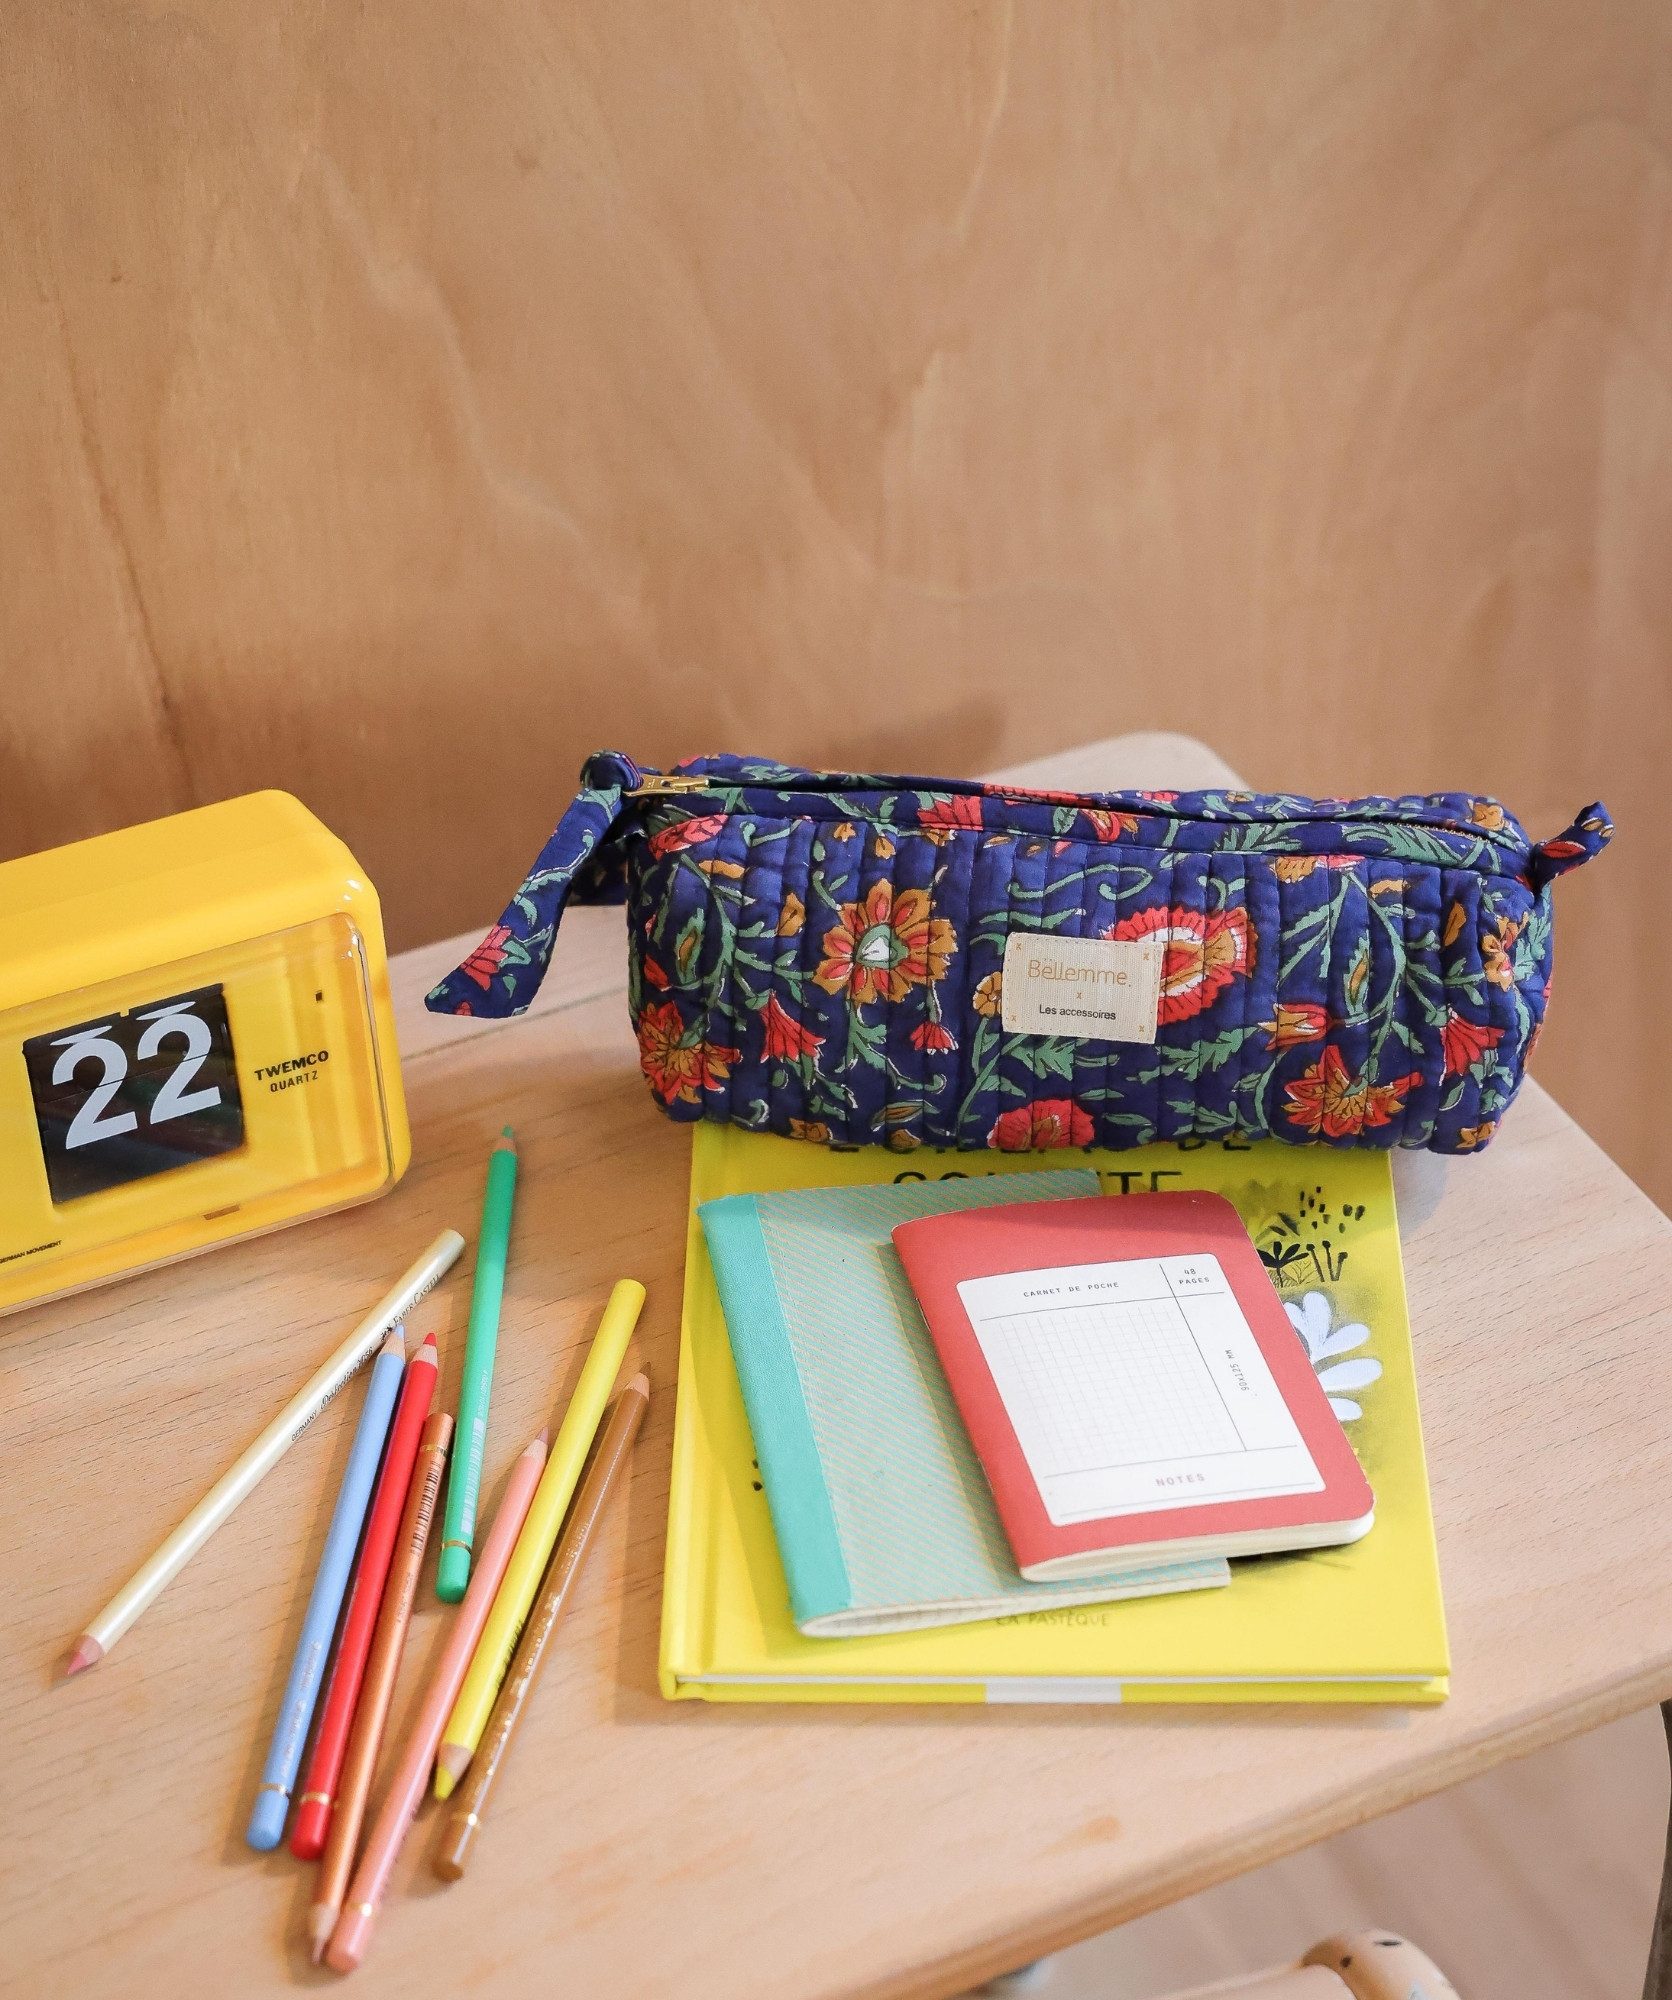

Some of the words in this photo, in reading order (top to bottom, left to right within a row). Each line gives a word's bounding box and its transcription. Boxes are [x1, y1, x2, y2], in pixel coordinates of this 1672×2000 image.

[1039, 1003, 1057, 1016] Les
[1059, 1008, 1117, 1021] accessoires
[254, 1049, 330, 1082] TWEMCO
[52, 1012, 222, 1150] 22
[269, 1070, 319, 1093] QUARTZ
[26, 1239, 62, 1255] MOVEMENT
[1178, 1276, 1211, 1285] PAGES
[1184, 1268, 1197, 1276] 48
[1023, 1287, 1061, 1298] CARNET
[1069, 1285, 1081, 1293] DE
[1088, 1281, 1120, 1290] POCHE
[1155, 1472, 1206, 1488] NOTES
